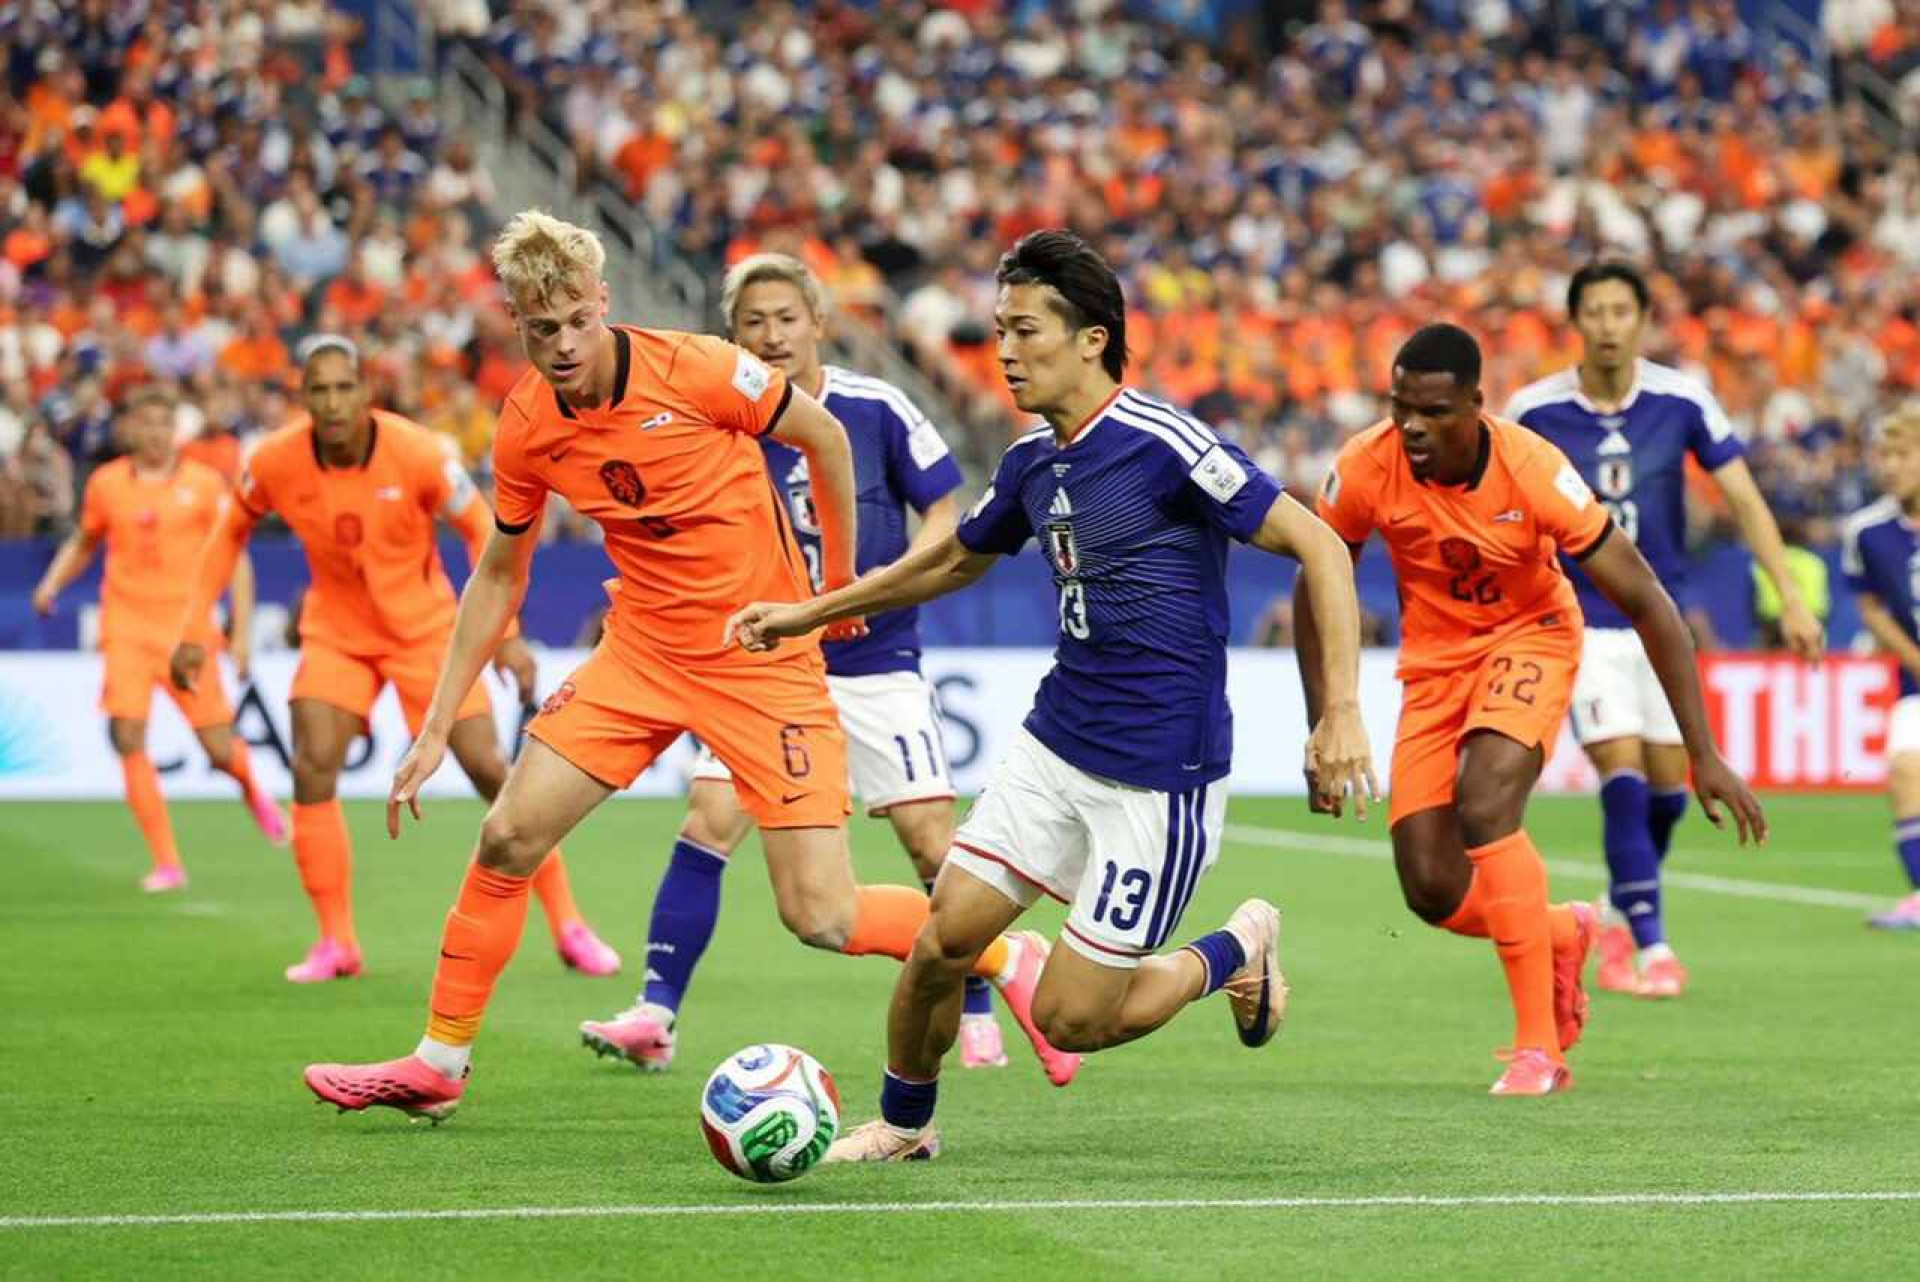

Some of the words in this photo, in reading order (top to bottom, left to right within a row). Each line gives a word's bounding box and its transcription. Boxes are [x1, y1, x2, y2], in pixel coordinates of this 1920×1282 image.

[1488, 657, 1543, 706] 22
[1706, 662, 1891, 783] THE
[780, 724, 810, 777] 6
[894, 729, 937, 782] 11
[1093, 859, 1152, 931] 13
